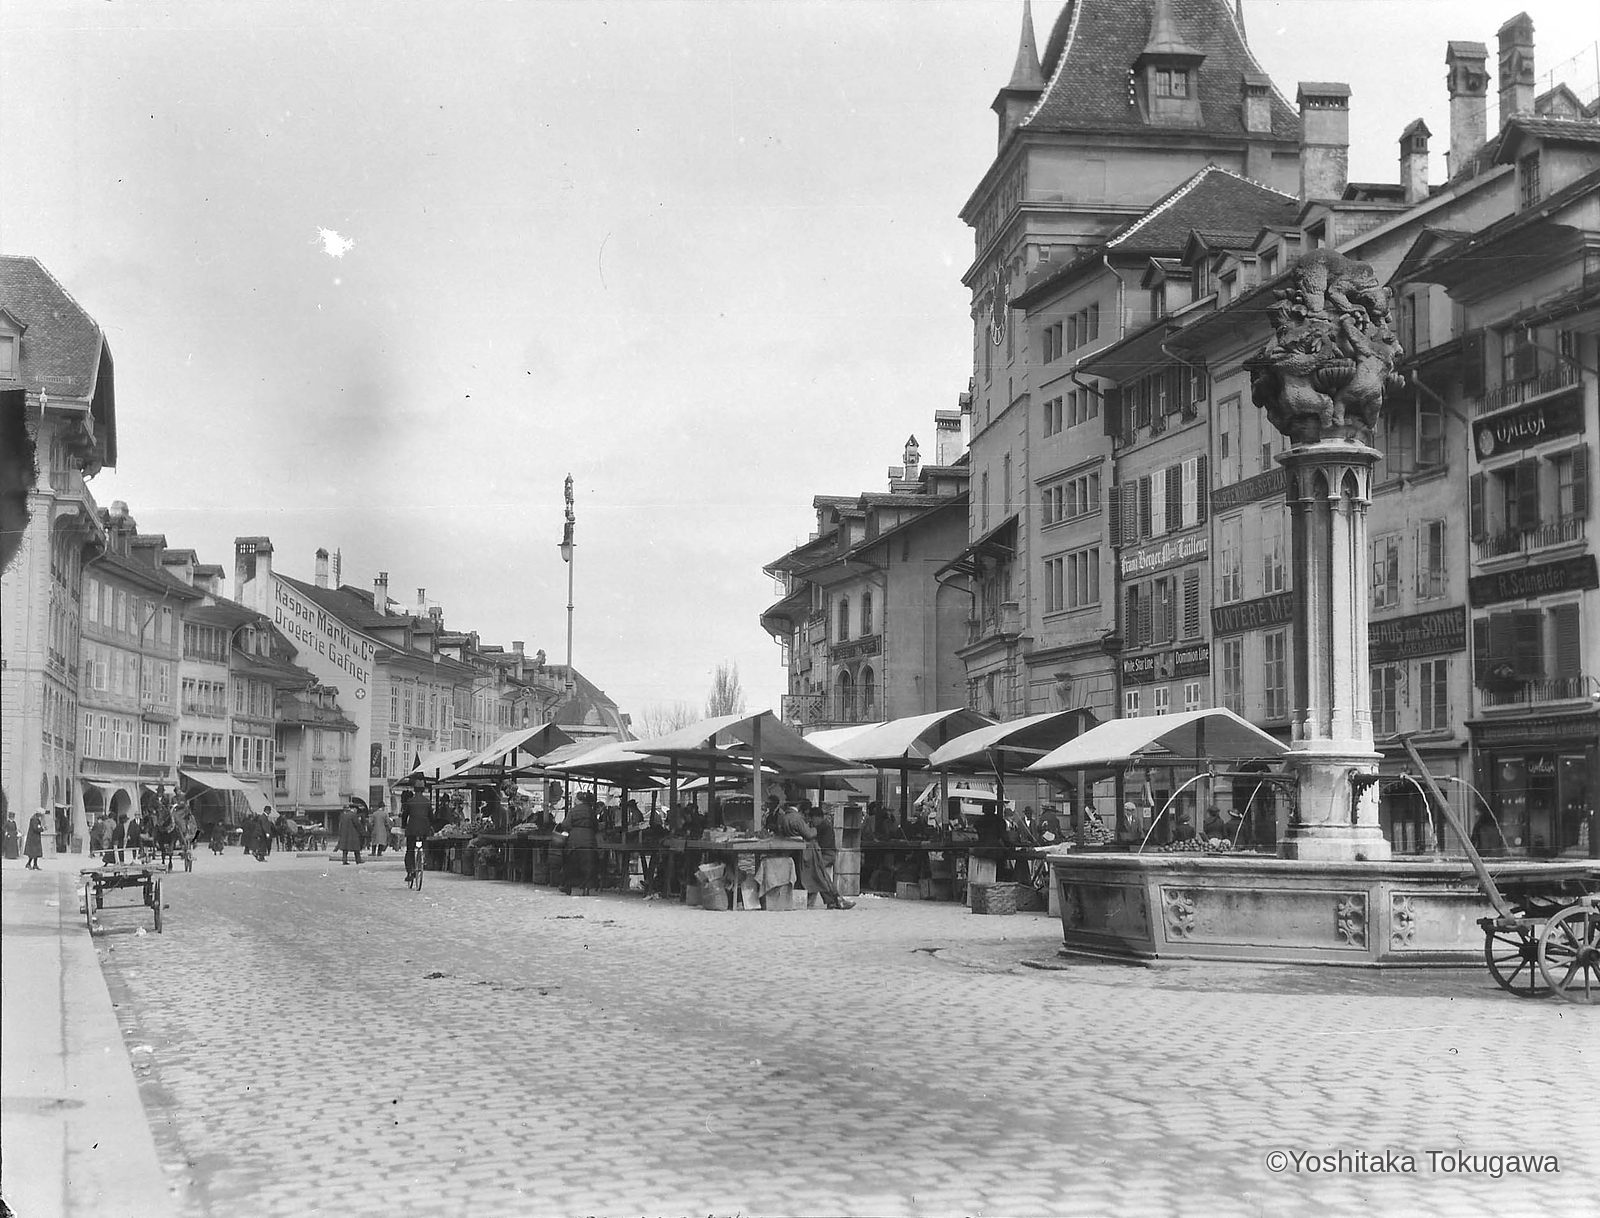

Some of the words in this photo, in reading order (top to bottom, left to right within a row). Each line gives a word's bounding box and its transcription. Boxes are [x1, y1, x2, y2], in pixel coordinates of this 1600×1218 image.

[275, 581, 315, 623] Kaspar
[1214, 602, 1267, 631] UNTERE
[275, 606, 325, 656] Drogerie
[328, 643, 370, 684] Gafner
